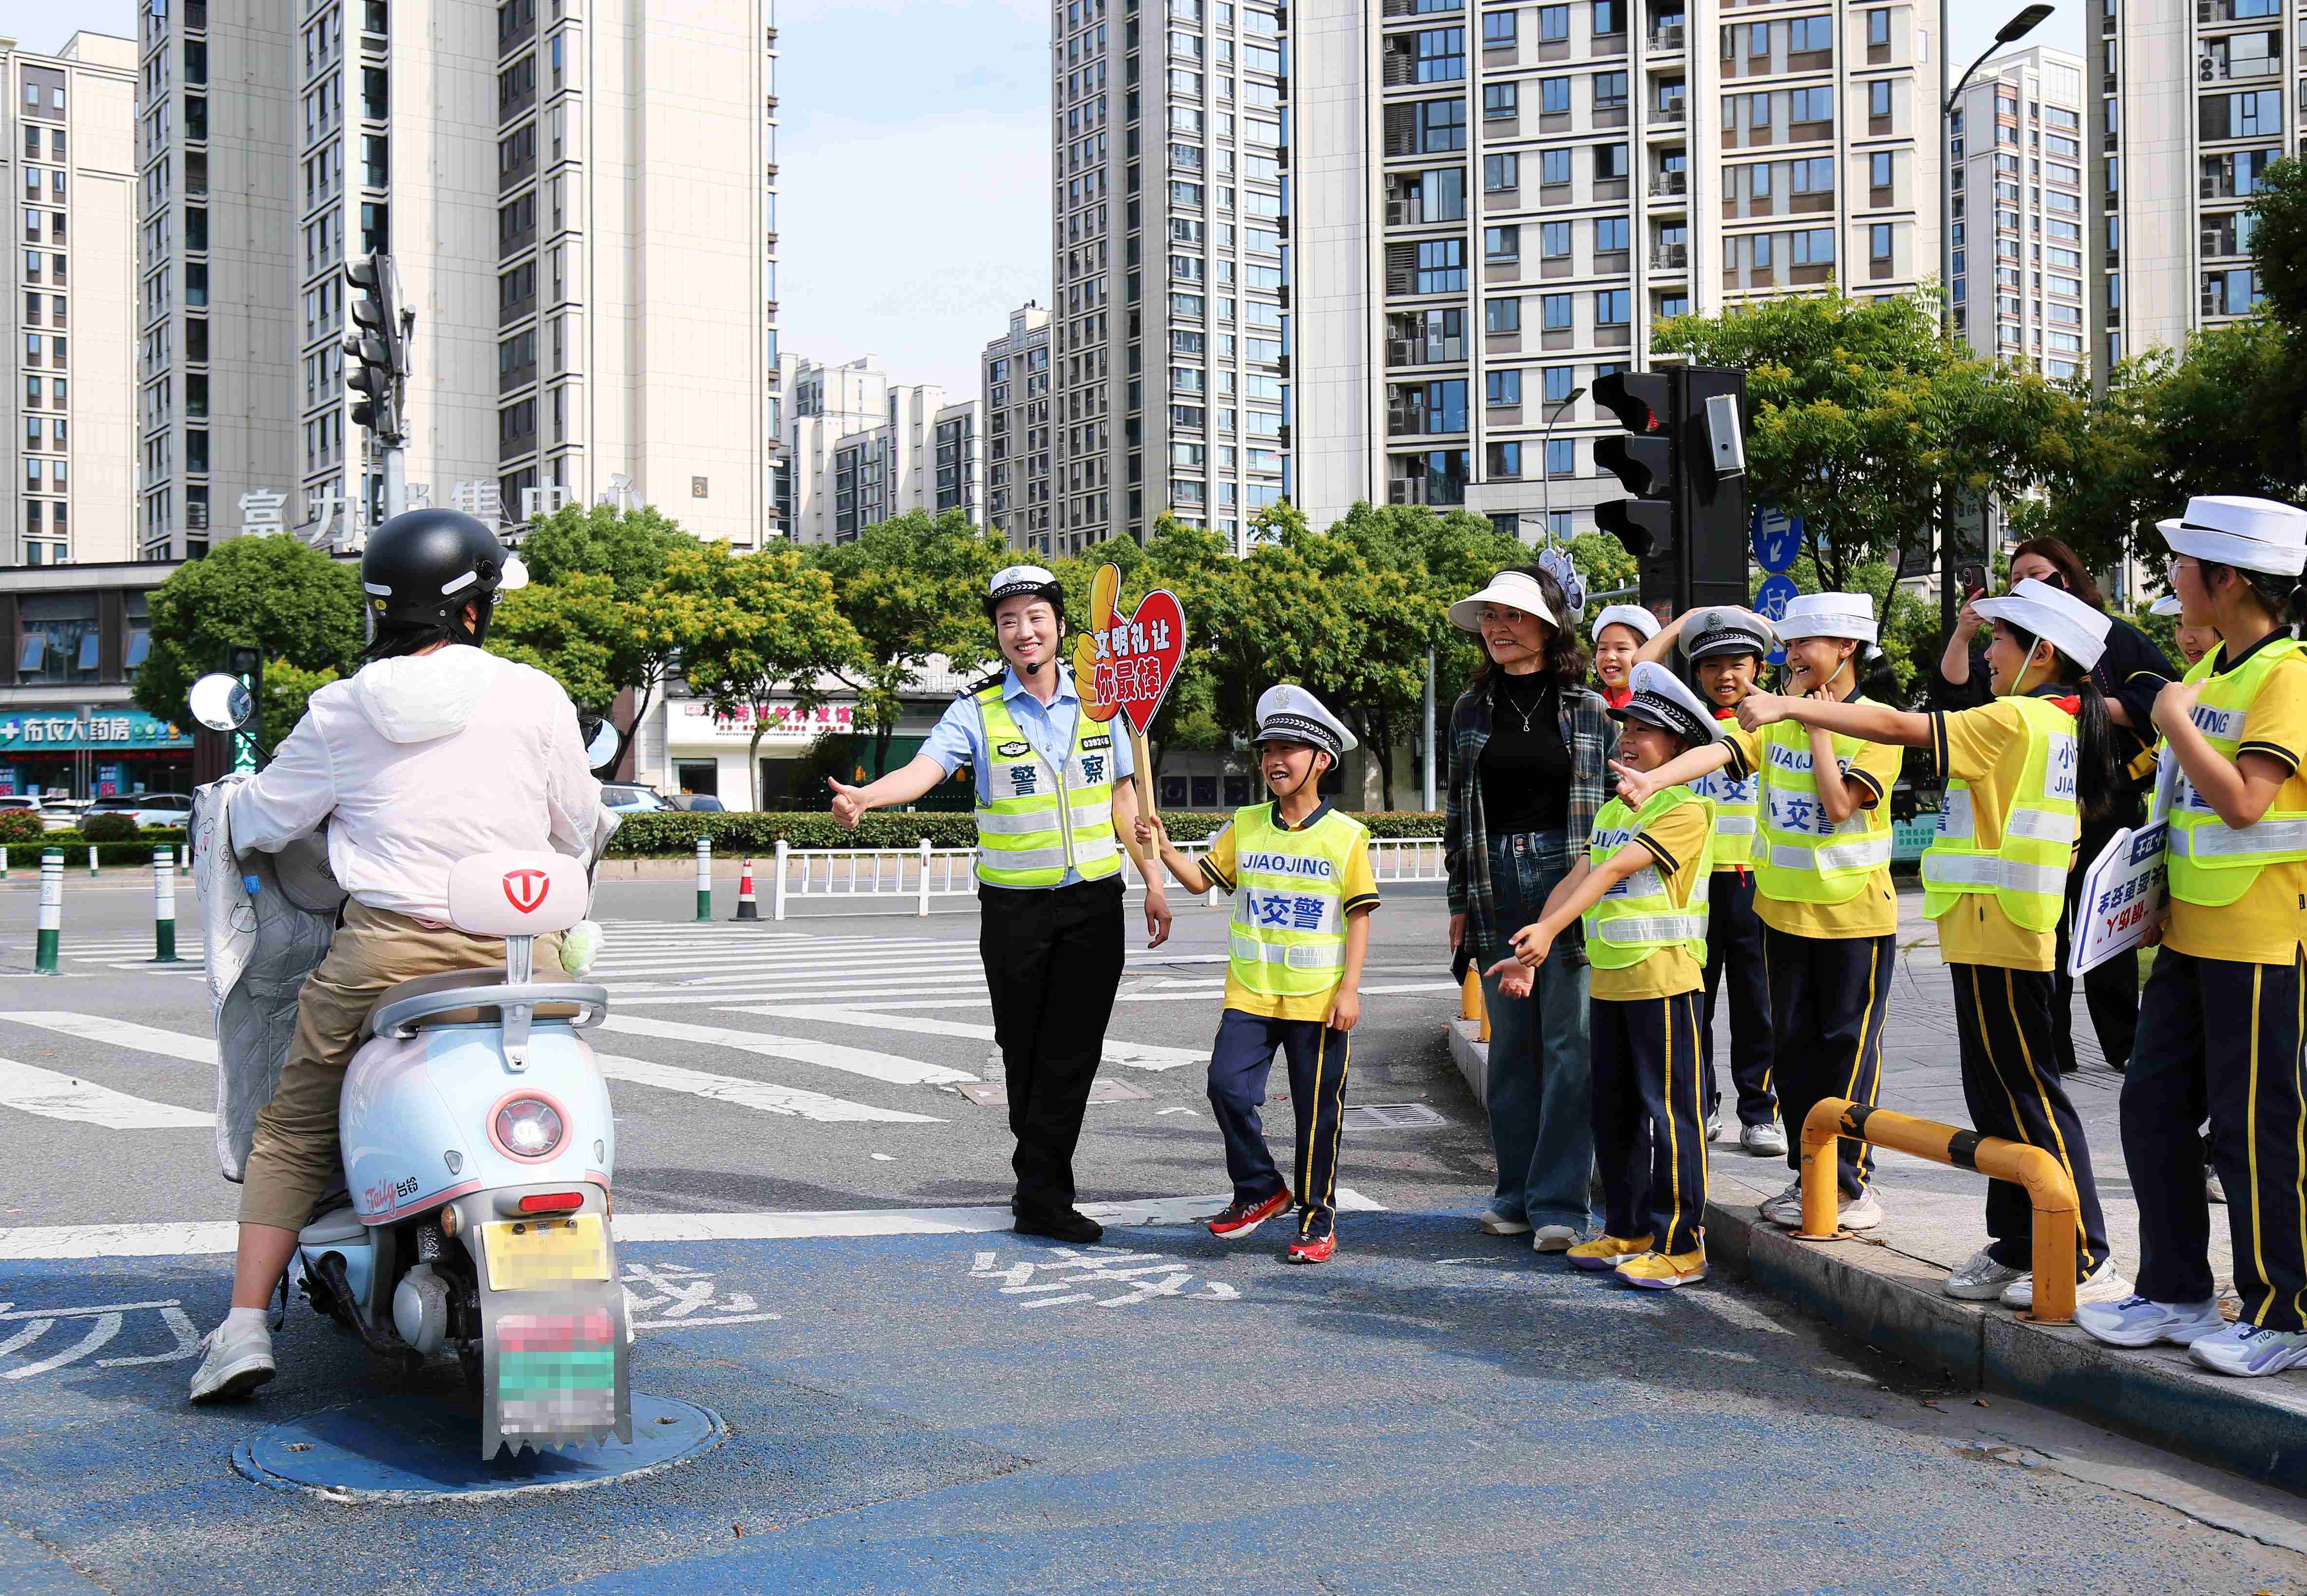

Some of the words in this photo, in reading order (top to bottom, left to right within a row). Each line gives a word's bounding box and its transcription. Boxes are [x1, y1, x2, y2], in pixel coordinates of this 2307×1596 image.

[238, 474, 646, 545] 富力售中心
[1095, 619, 1170, 661] 文明礼让
[1094, 656, 1162, 706] 你最棒
[23, 718, 130, 741] 布衣大药房
[1011, 765, 1037, 796] 警
[1081, 755, 1104, 783] 察
[1243, 855, 1330, 876] JIAOJING
[1247, 892, 1325, 930] 小交警
